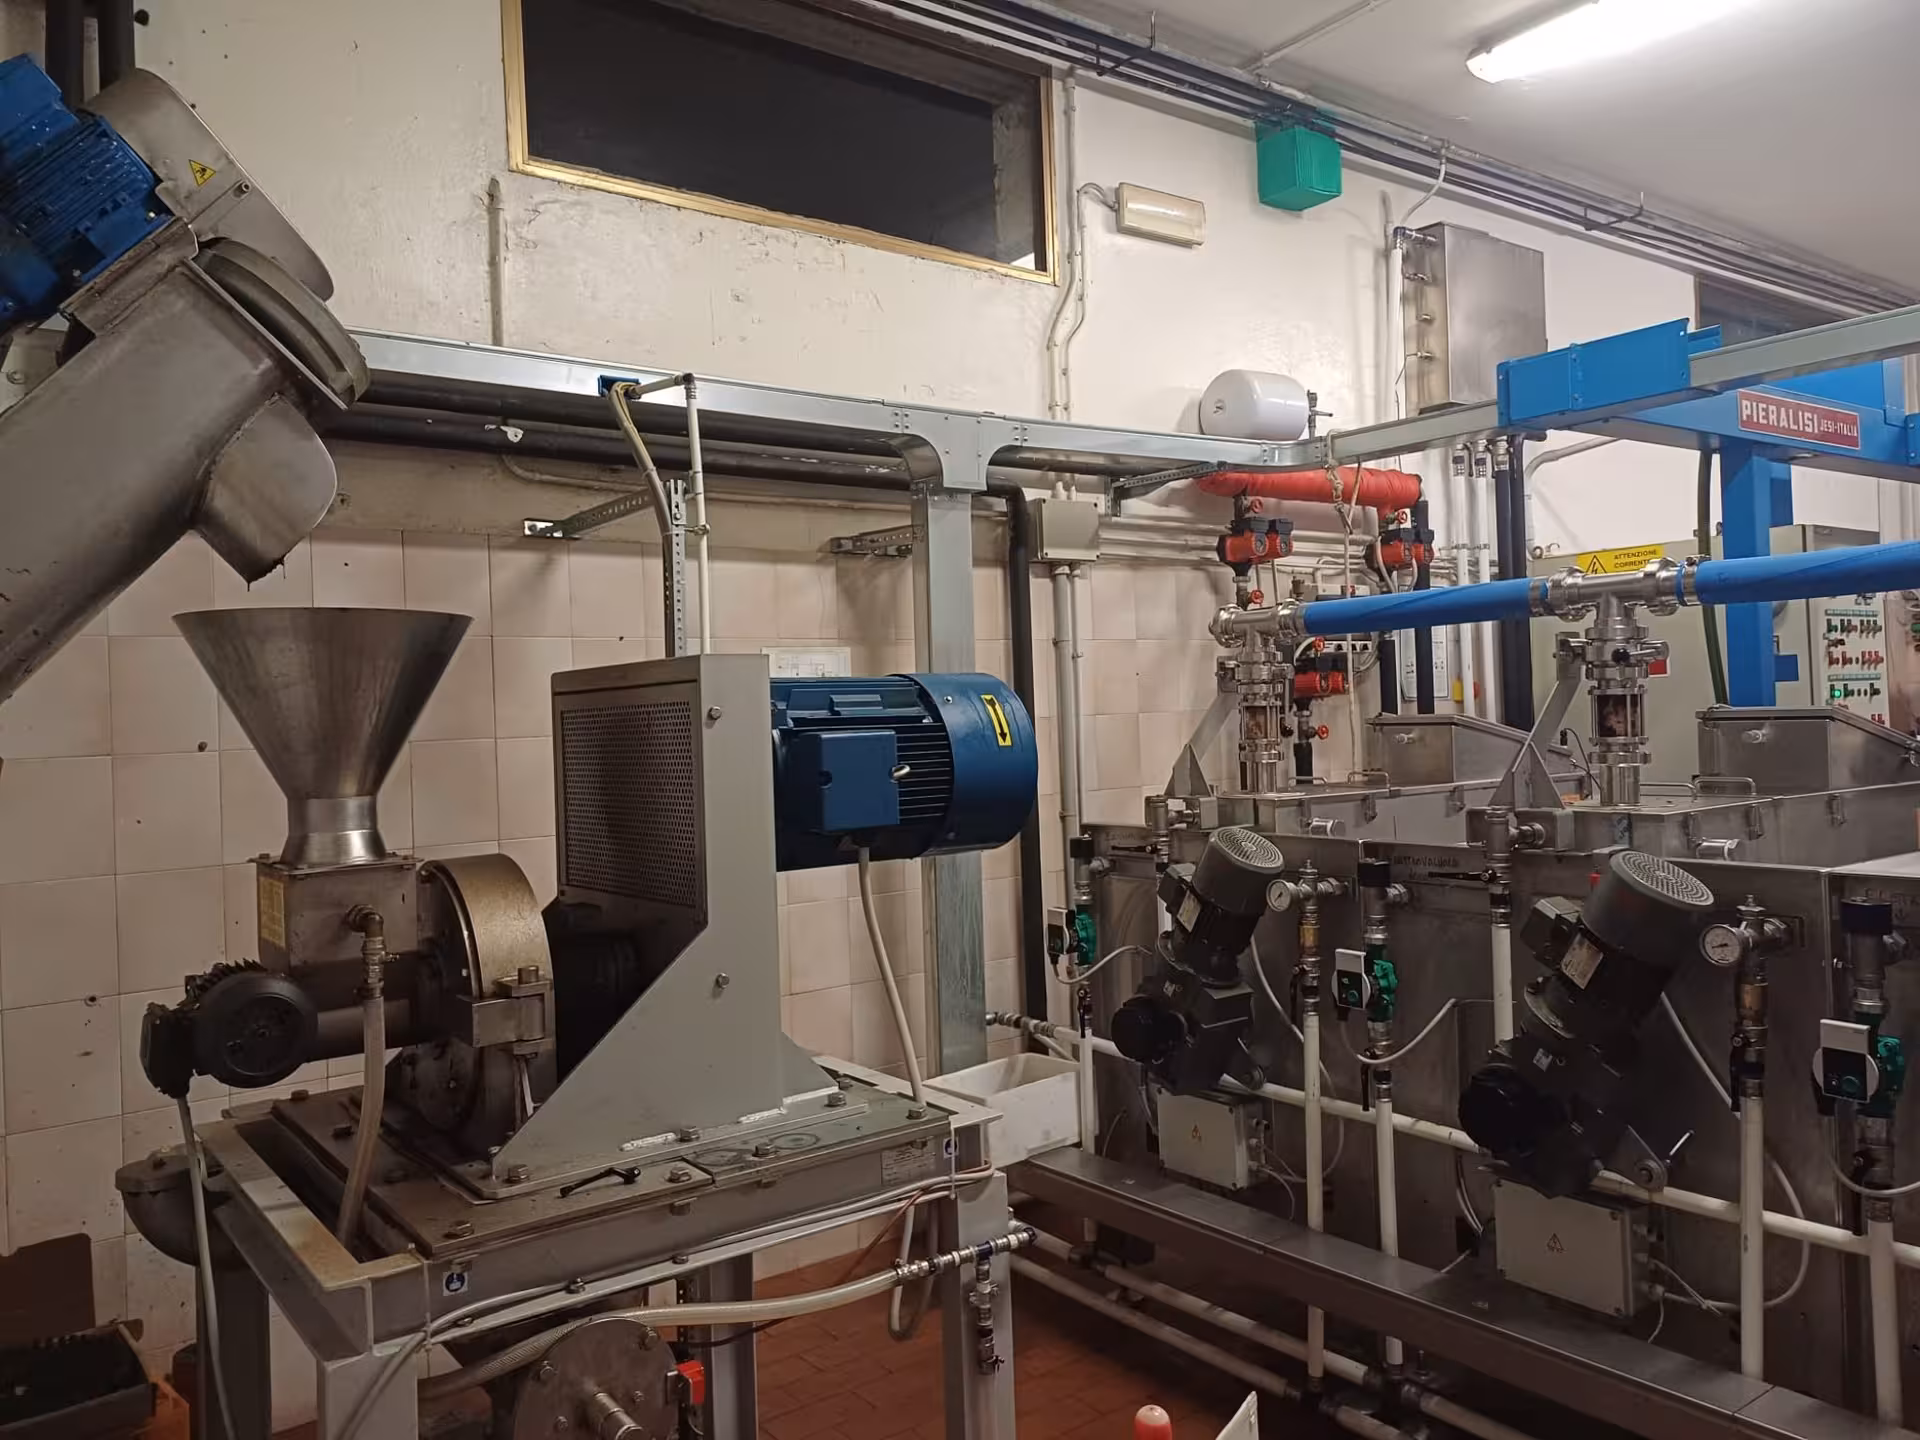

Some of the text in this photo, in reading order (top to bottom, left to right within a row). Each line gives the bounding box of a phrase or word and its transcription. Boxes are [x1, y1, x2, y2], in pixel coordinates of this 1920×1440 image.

[1741, 399, 1857, 437] PIERALISI JESI-ITALIA
[1614, 549, 1657, 560] ATTENZIONE
